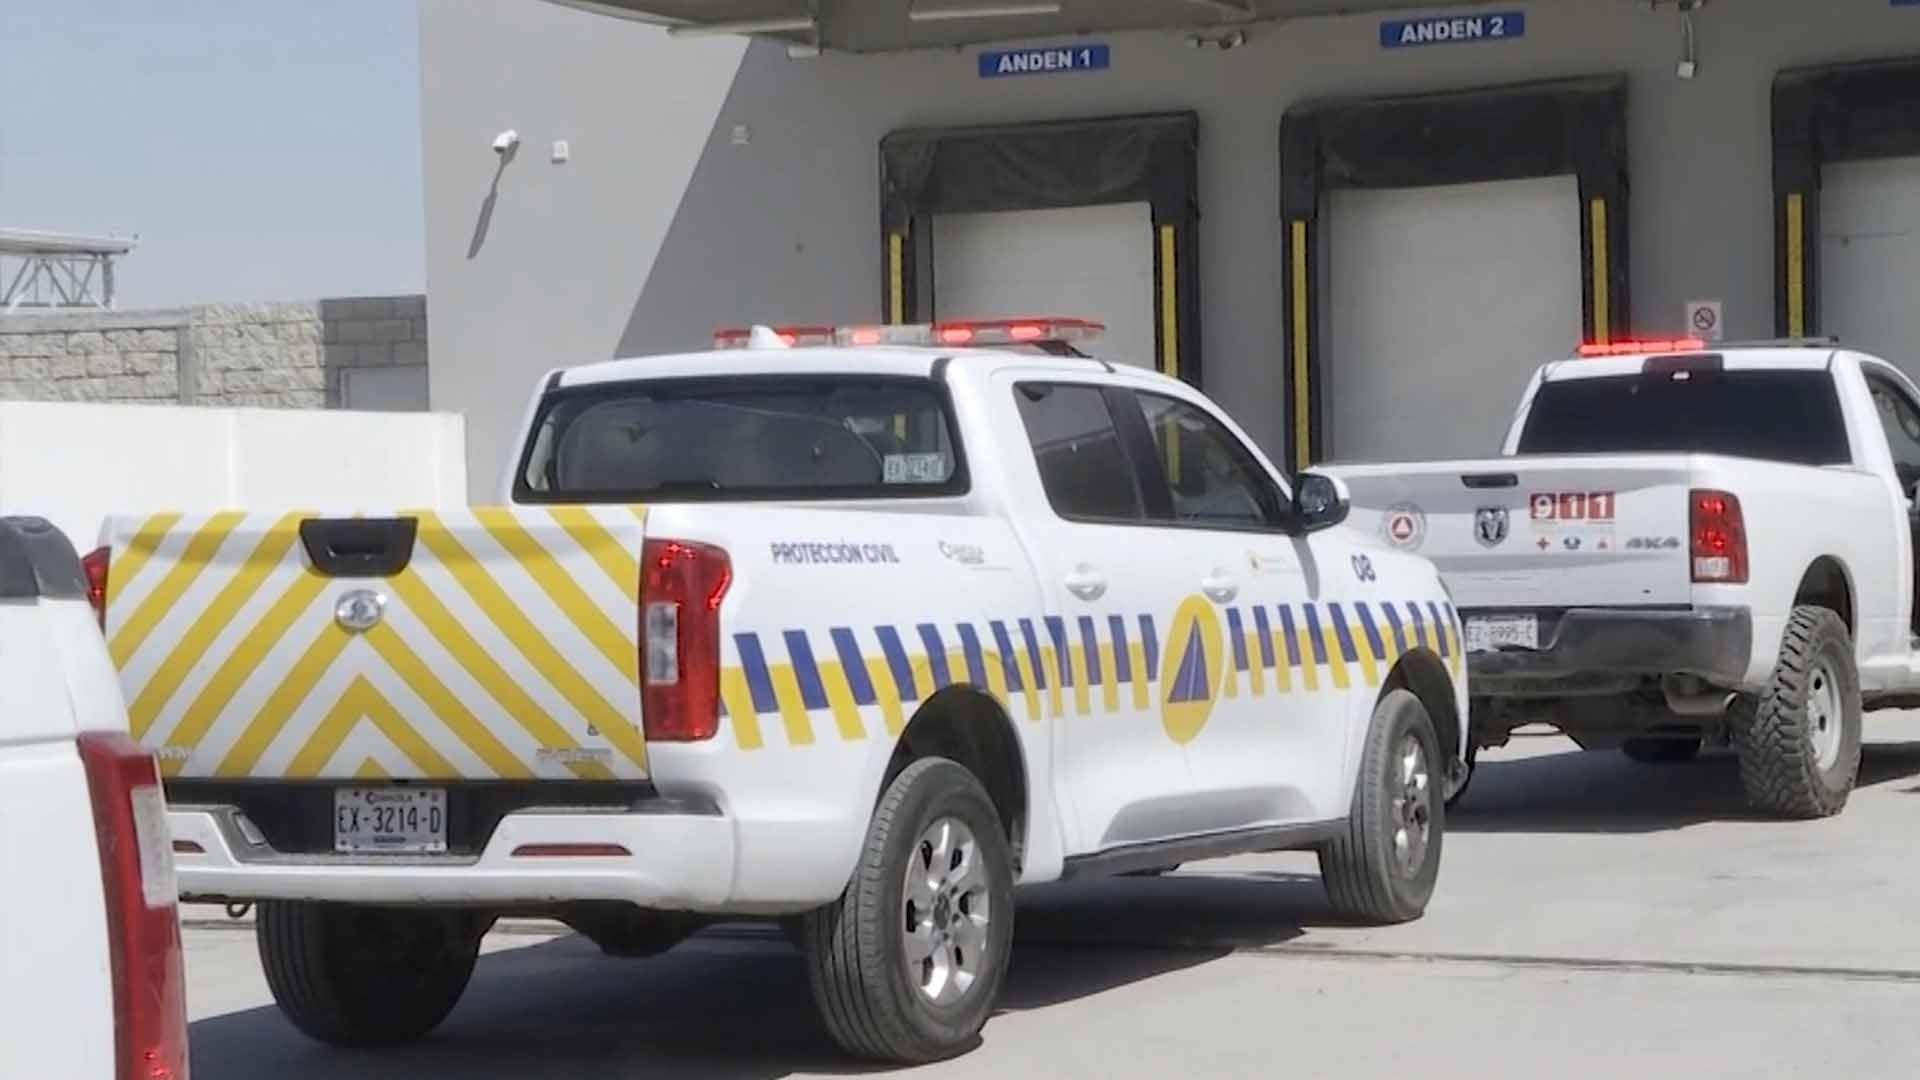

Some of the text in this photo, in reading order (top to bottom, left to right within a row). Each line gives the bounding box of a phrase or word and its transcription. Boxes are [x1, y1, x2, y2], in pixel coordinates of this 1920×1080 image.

[1400, 16, 1504, 43] ANDEN 2
[998, 48, 1091, 73] ANDEN 1
[1533, 494, 1613, 518] 911
[770, 539, 900, 564] PROTECCIÓN CIVIL
[1351, 553, 1376, 582] 08
[338, 805, 441, 833] EX-3214-D
